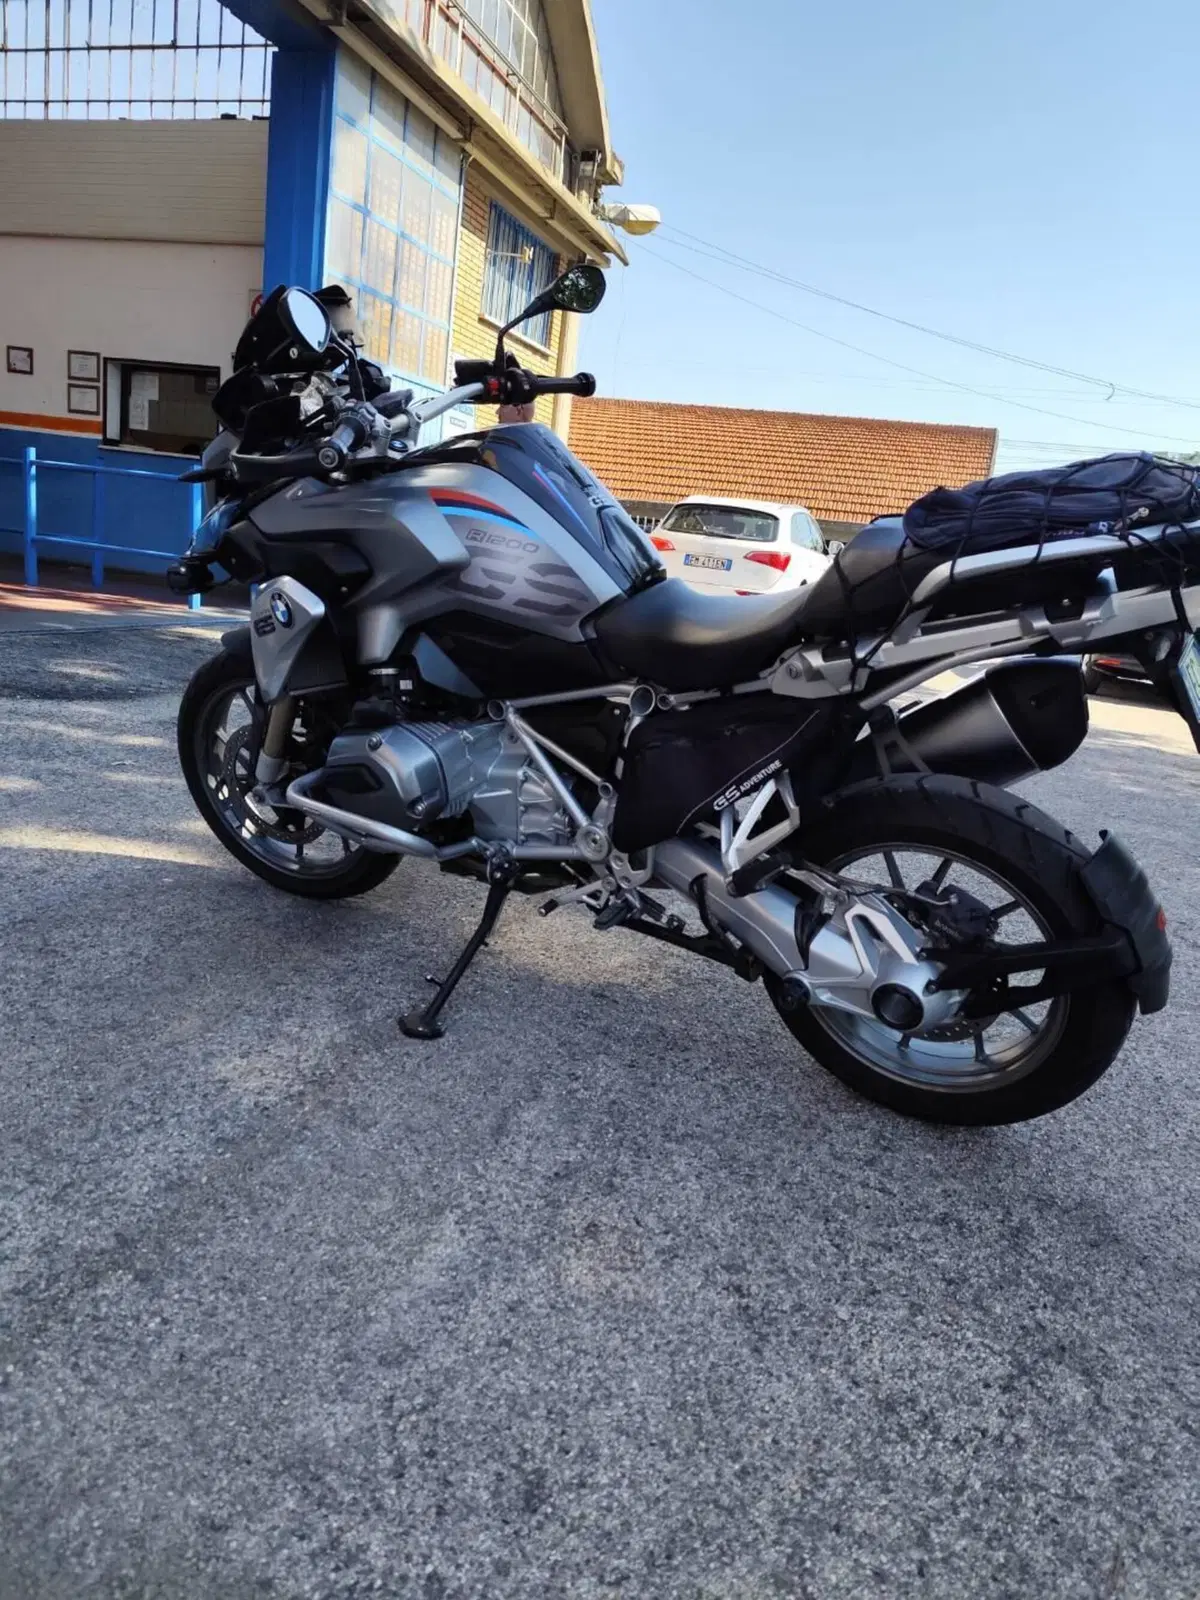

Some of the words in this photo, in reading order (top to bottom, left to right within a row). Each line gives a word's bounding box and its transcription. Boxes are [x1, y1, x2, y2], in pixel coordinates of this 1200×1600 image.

[466, 528, 540, 554] R1200
[713, 785, 741, 811] GS
[740, 759, 782, 792] ADVENTURE
